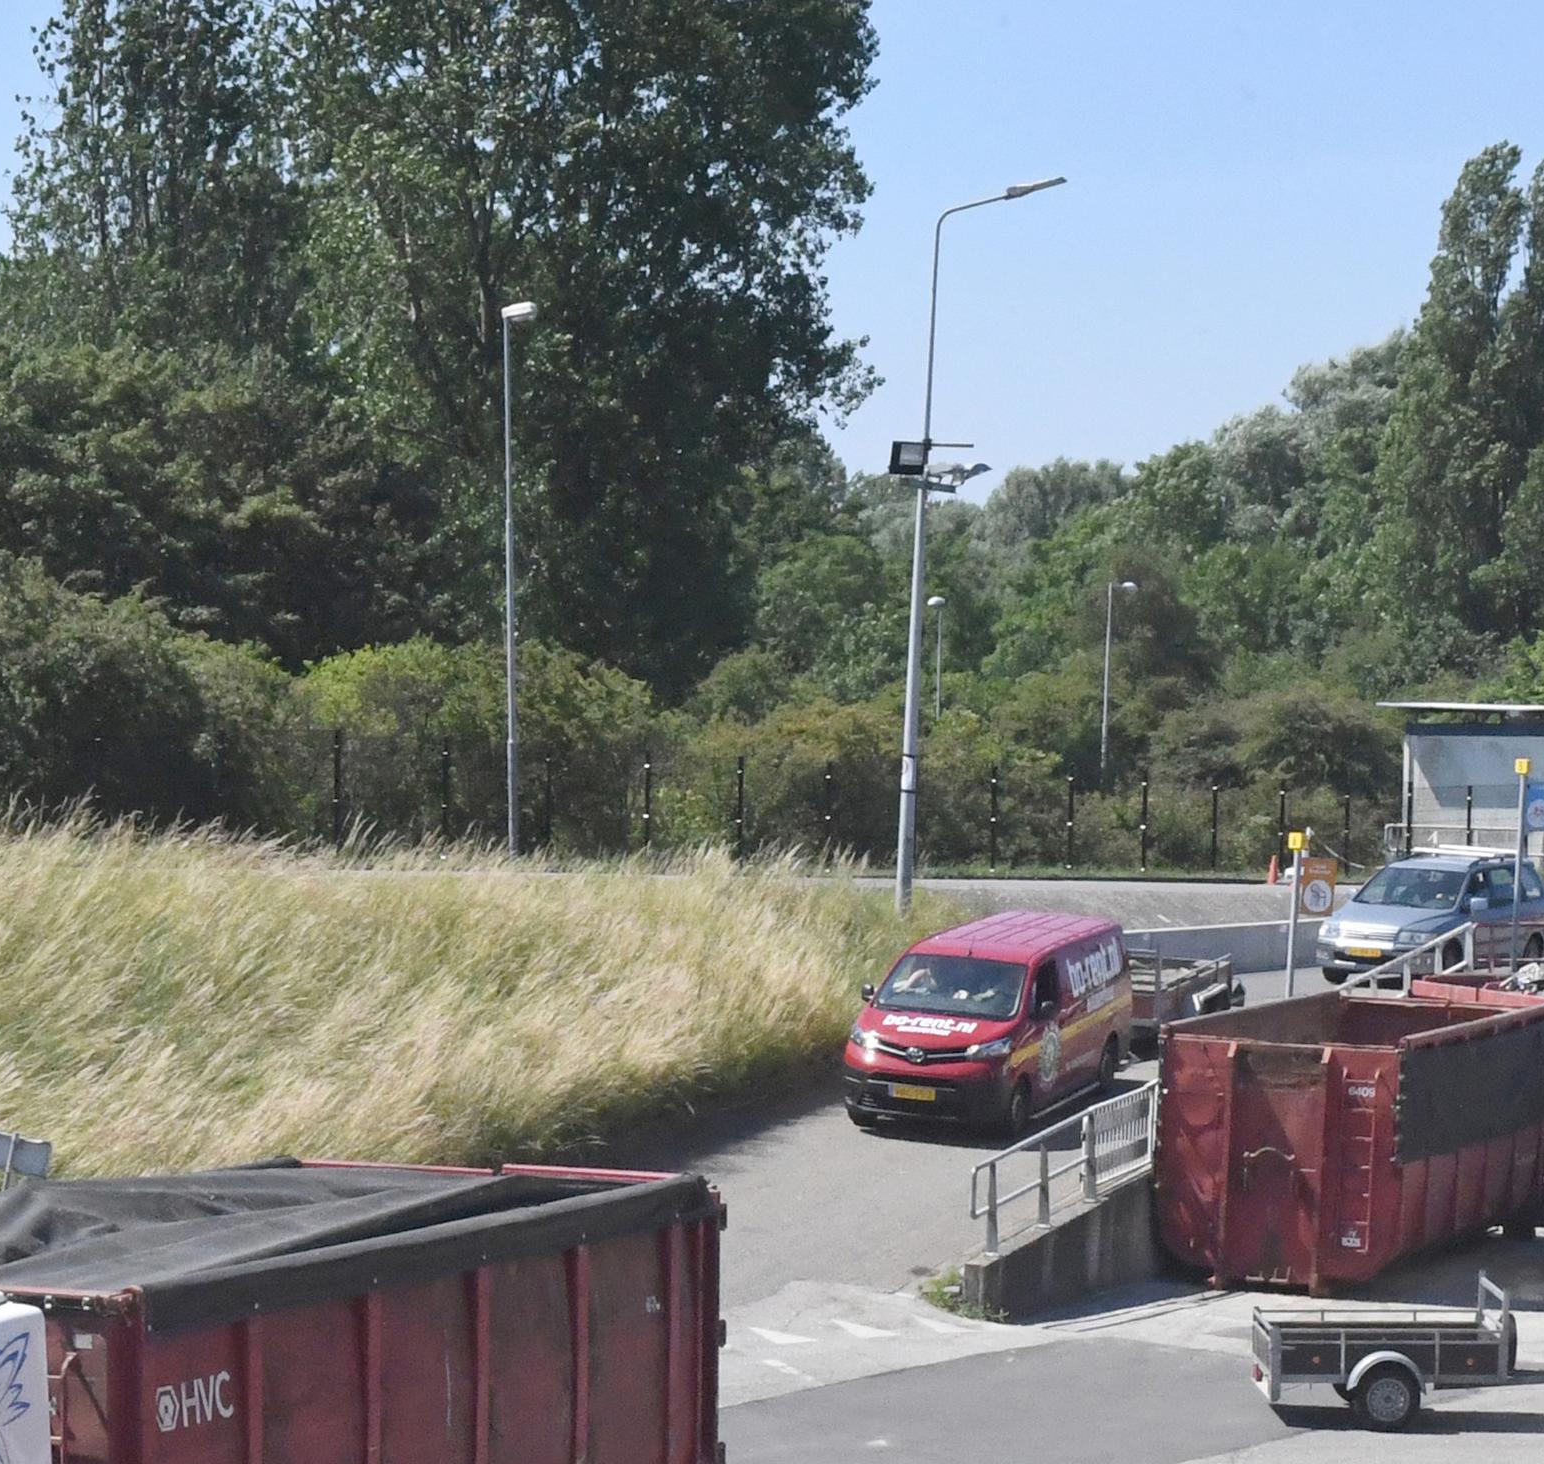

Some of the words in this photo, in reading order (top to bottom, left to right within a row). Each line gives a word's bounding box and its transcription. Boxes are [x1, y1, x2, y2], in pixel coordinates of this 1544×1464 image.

[1066, 936, 1124, 998] bo-rent.nl
[882, 1014, 978, 1034] bo-rent.nl
[1348, 1086, 1376, 1098] 6409
[181, 1370, 234, 1429] HVC
